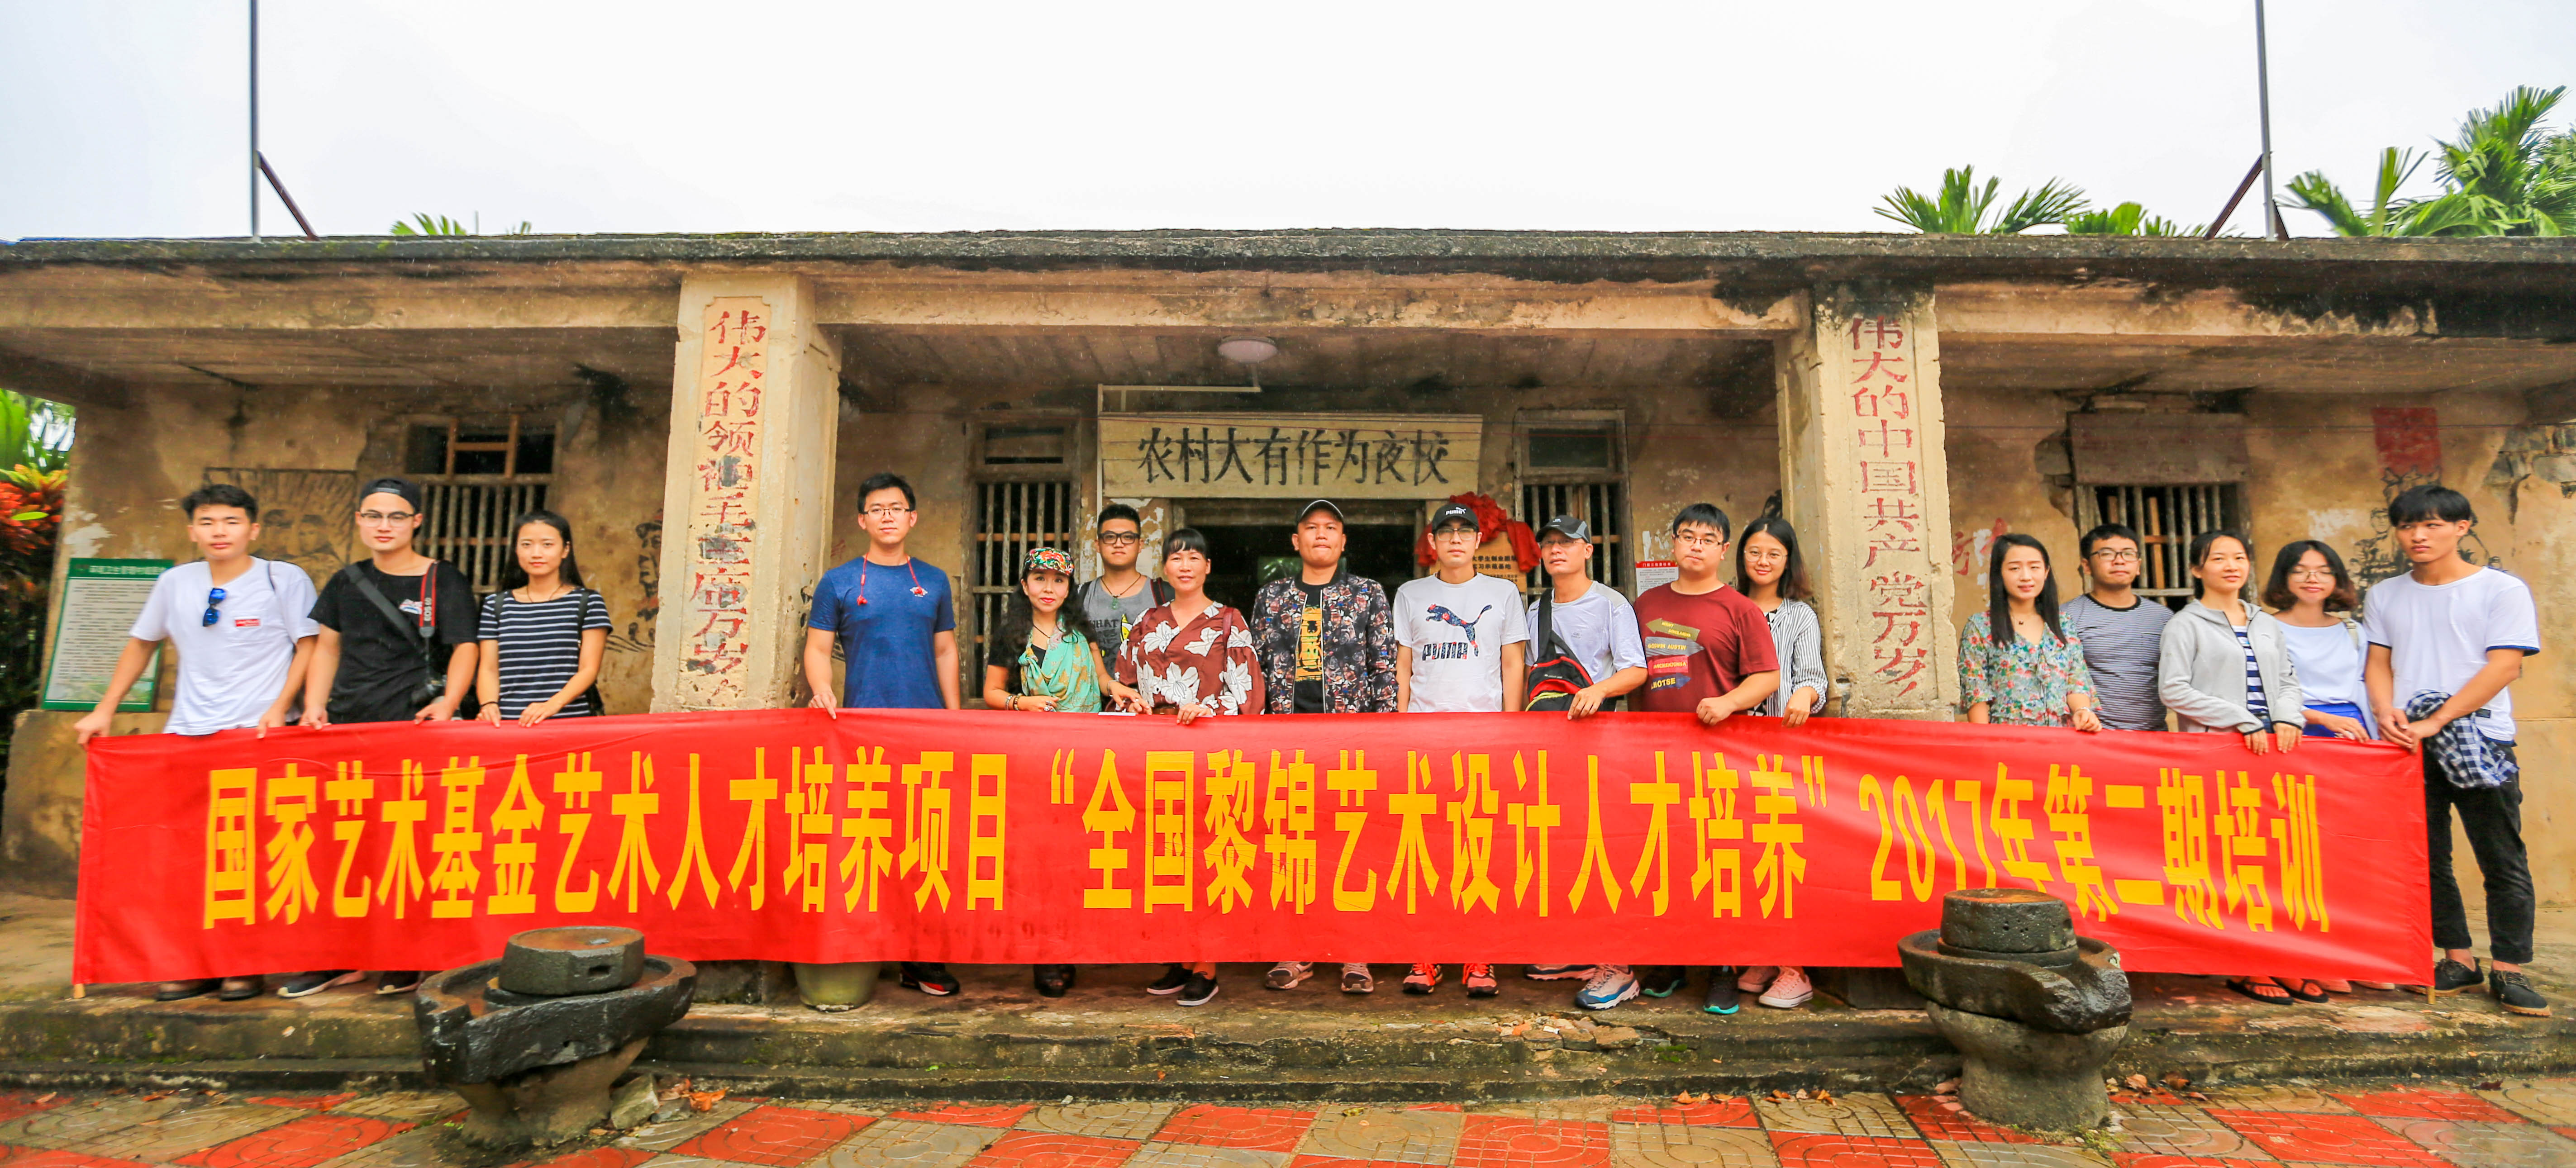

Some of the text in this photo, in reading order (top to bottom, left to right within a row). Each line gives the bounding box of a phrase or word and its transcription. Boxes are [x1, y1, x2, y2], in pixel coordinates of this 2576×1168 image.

[1138, 427, 1449, 487] 农村大有作为夜校
[1422, 641, 1469, 661] PUMA
